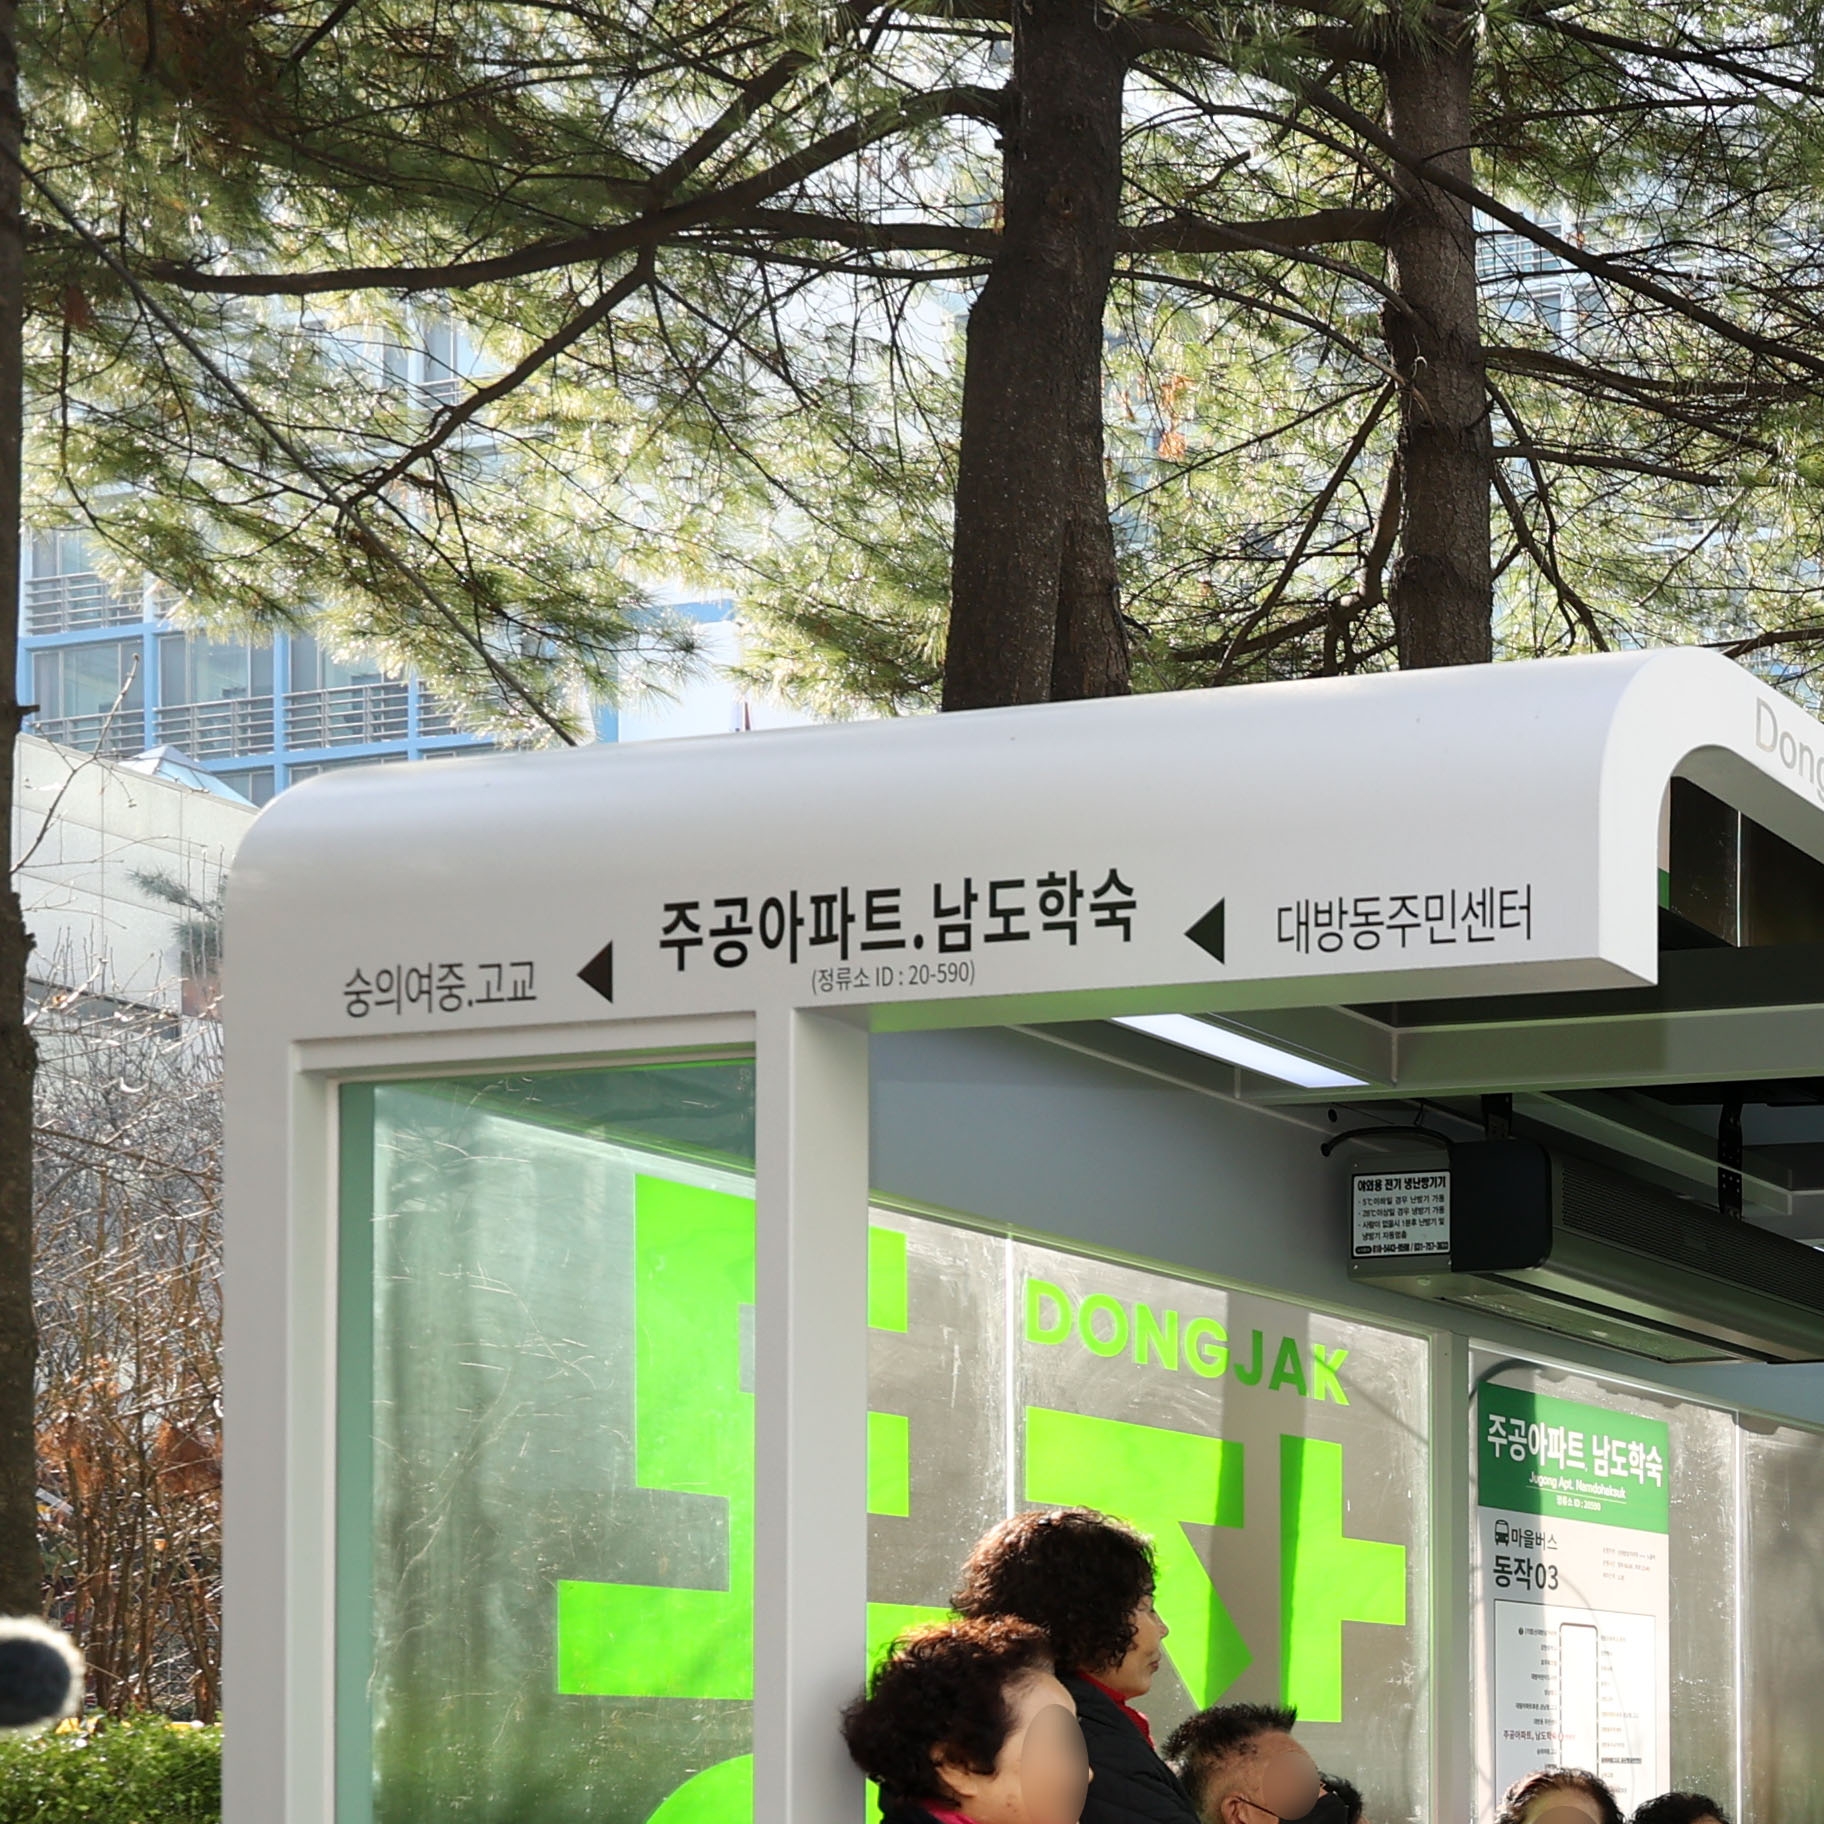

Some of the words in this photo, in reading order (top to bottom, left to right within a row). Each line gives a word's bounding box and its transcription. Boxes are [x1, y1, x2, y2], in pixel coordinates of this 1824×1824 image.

[659, 867, 1137, 972] 주공아파트.남도학숙
[1276, 883, 1533, 954] 대방동주민센터
[343, 960, 537, 1018] 숭의여중.고교
[811, 964, 869, 995] (정류소
[874, 964, 895, 988] ID
[907, 958, 976, 986] 20-590)
[1357, 1179, 1382, 1192] 야외용
[1385, 1178, 1401, 1191] 전기
[1404, 1176, 1446, 1190] 냉난방기기
[1023, 1278, 1351, 1406] DONGJAK
[1529, 1471, 1557, 1490] Jugong
[1558, 1477, 1573, 1492] Apt.
[1592, 1434, 1663, 1488] 남도학숙
[1511, 1528, 1558, 1551] 마을버스
